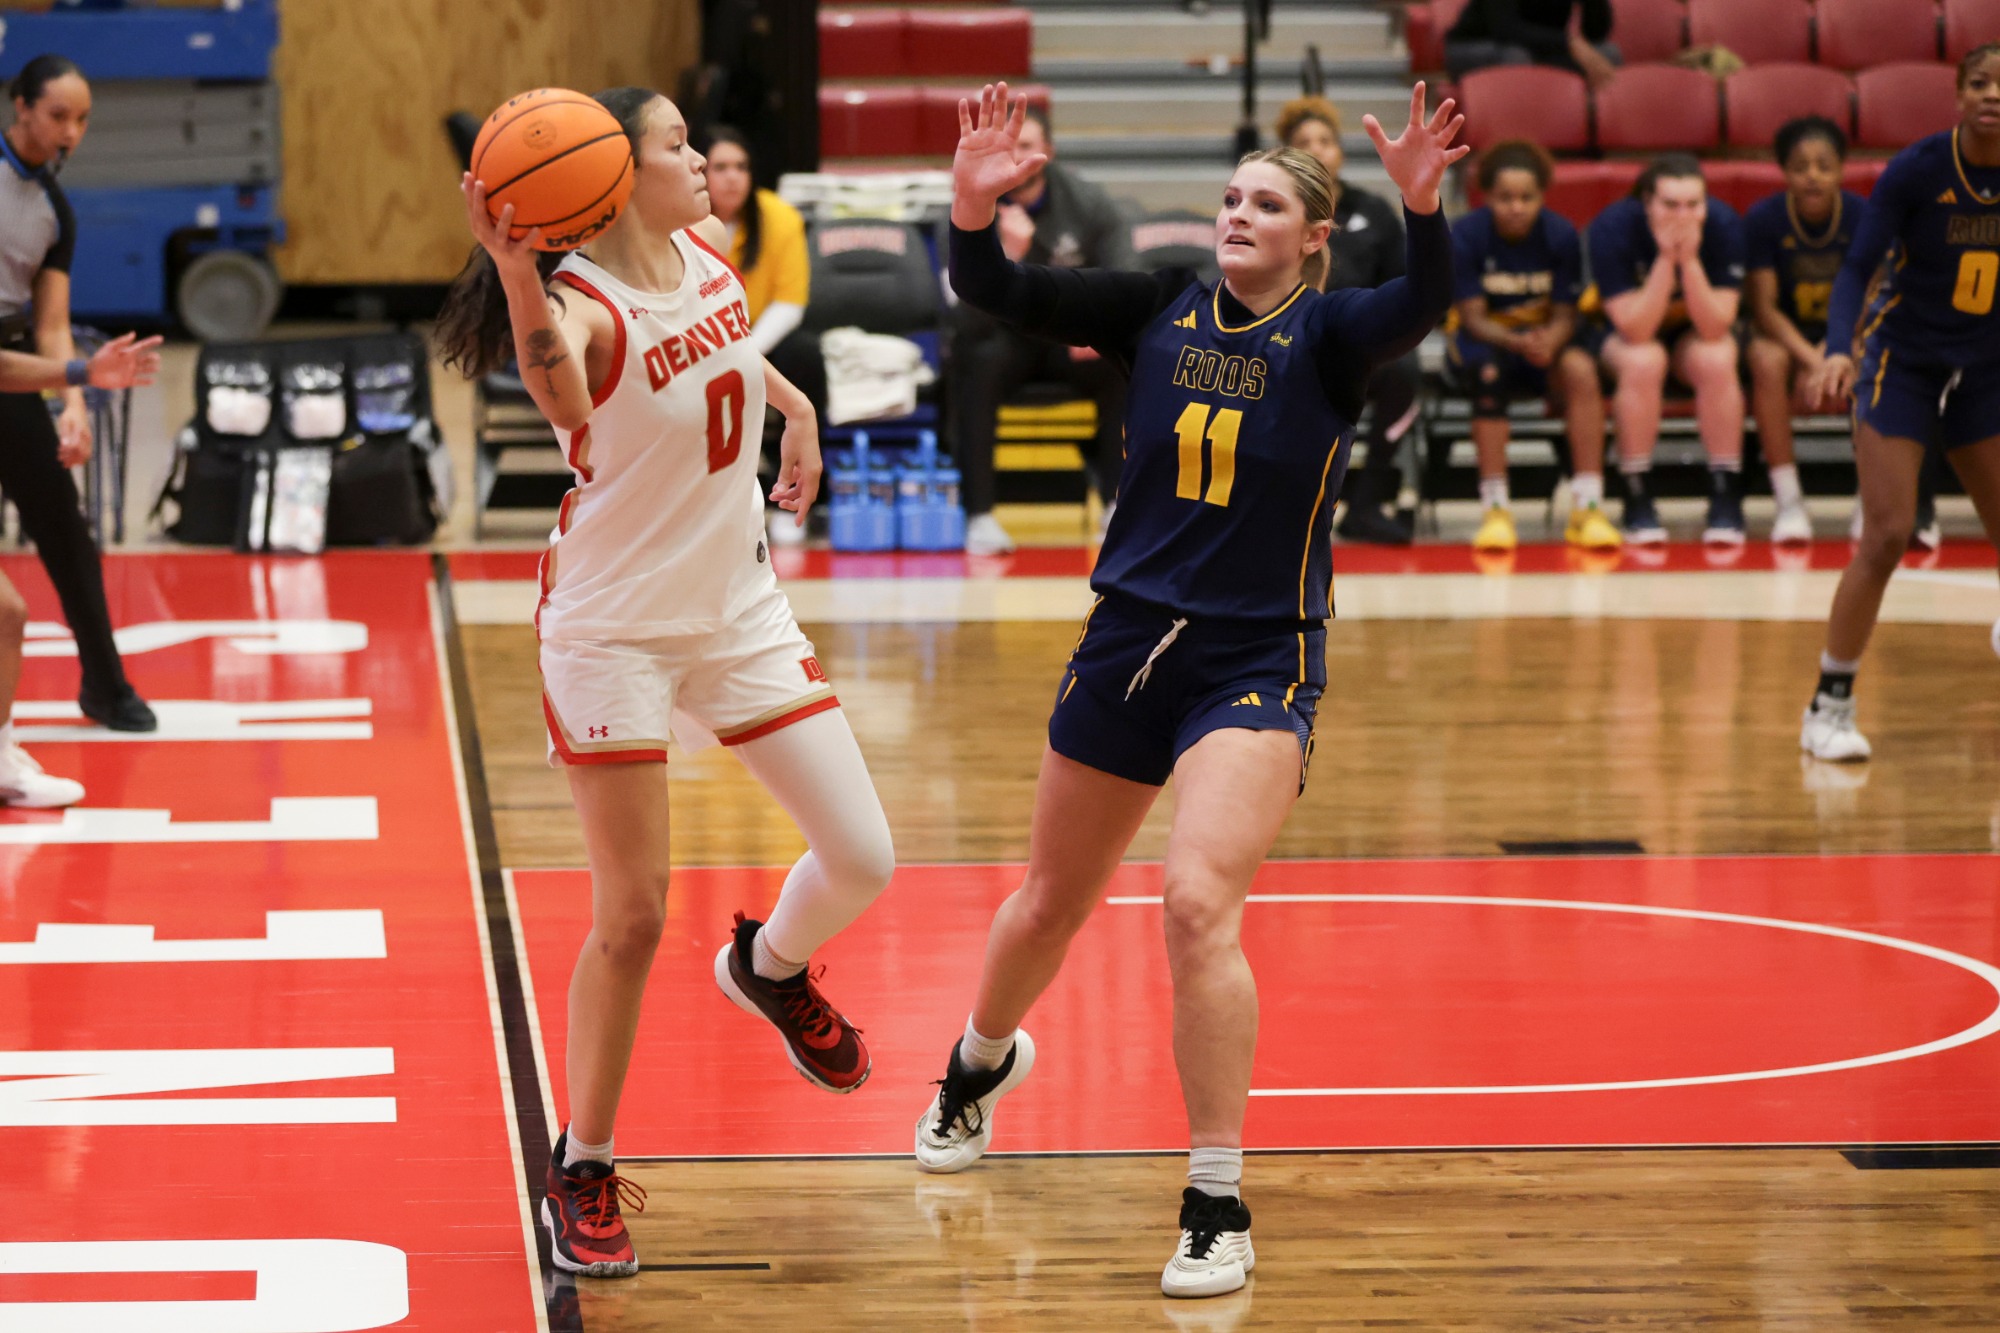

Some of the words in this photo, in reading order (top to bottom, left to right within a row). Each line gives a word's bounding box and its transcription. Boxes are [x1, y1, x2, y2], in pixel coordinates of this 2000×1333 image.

[699, 271, 732, 299] SUMMIT
[1952, 251, 1999, 315] 0
[643, 300, 751, 393] DENVER
[1173, 345, 1267, 400] ROOS
[705, 369, 745, 475] 0
[1174, 402, 1243, 507] 11
[799, 656, 828, 683] D
